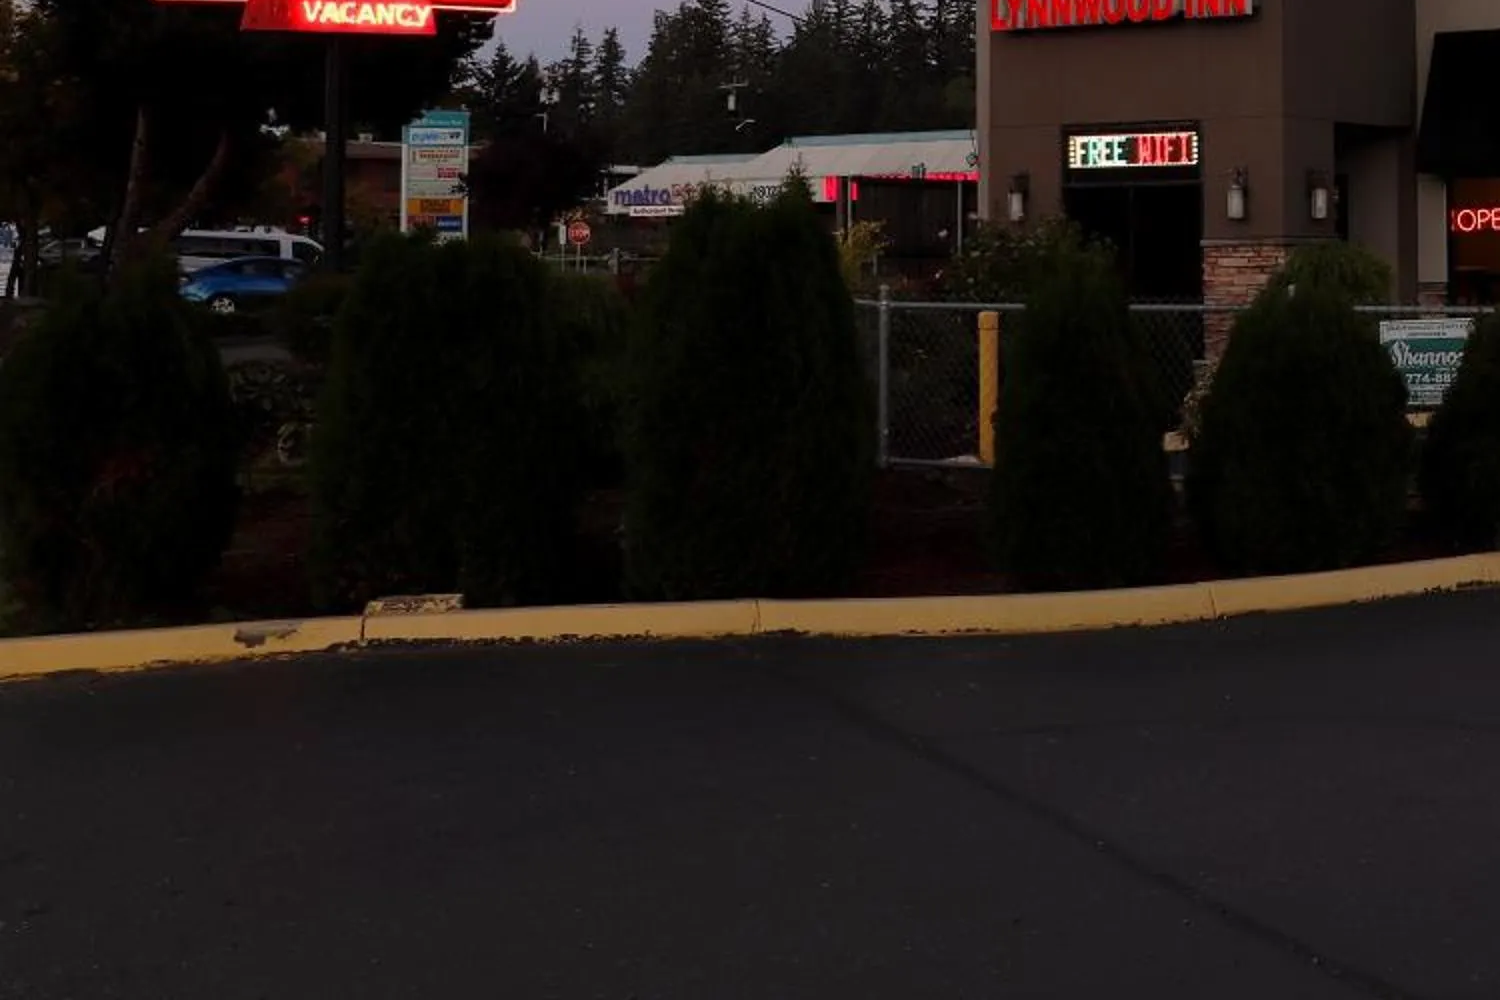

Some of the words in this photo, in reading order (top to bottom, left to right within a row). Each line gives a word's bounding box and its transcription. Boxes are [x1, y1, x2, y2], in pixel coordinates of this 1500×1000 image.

[302, 0, 432, 27] VACANCY
[1076, 136, 1127, 166] FREE
[1138, 133, 1190, 165] WIFI
